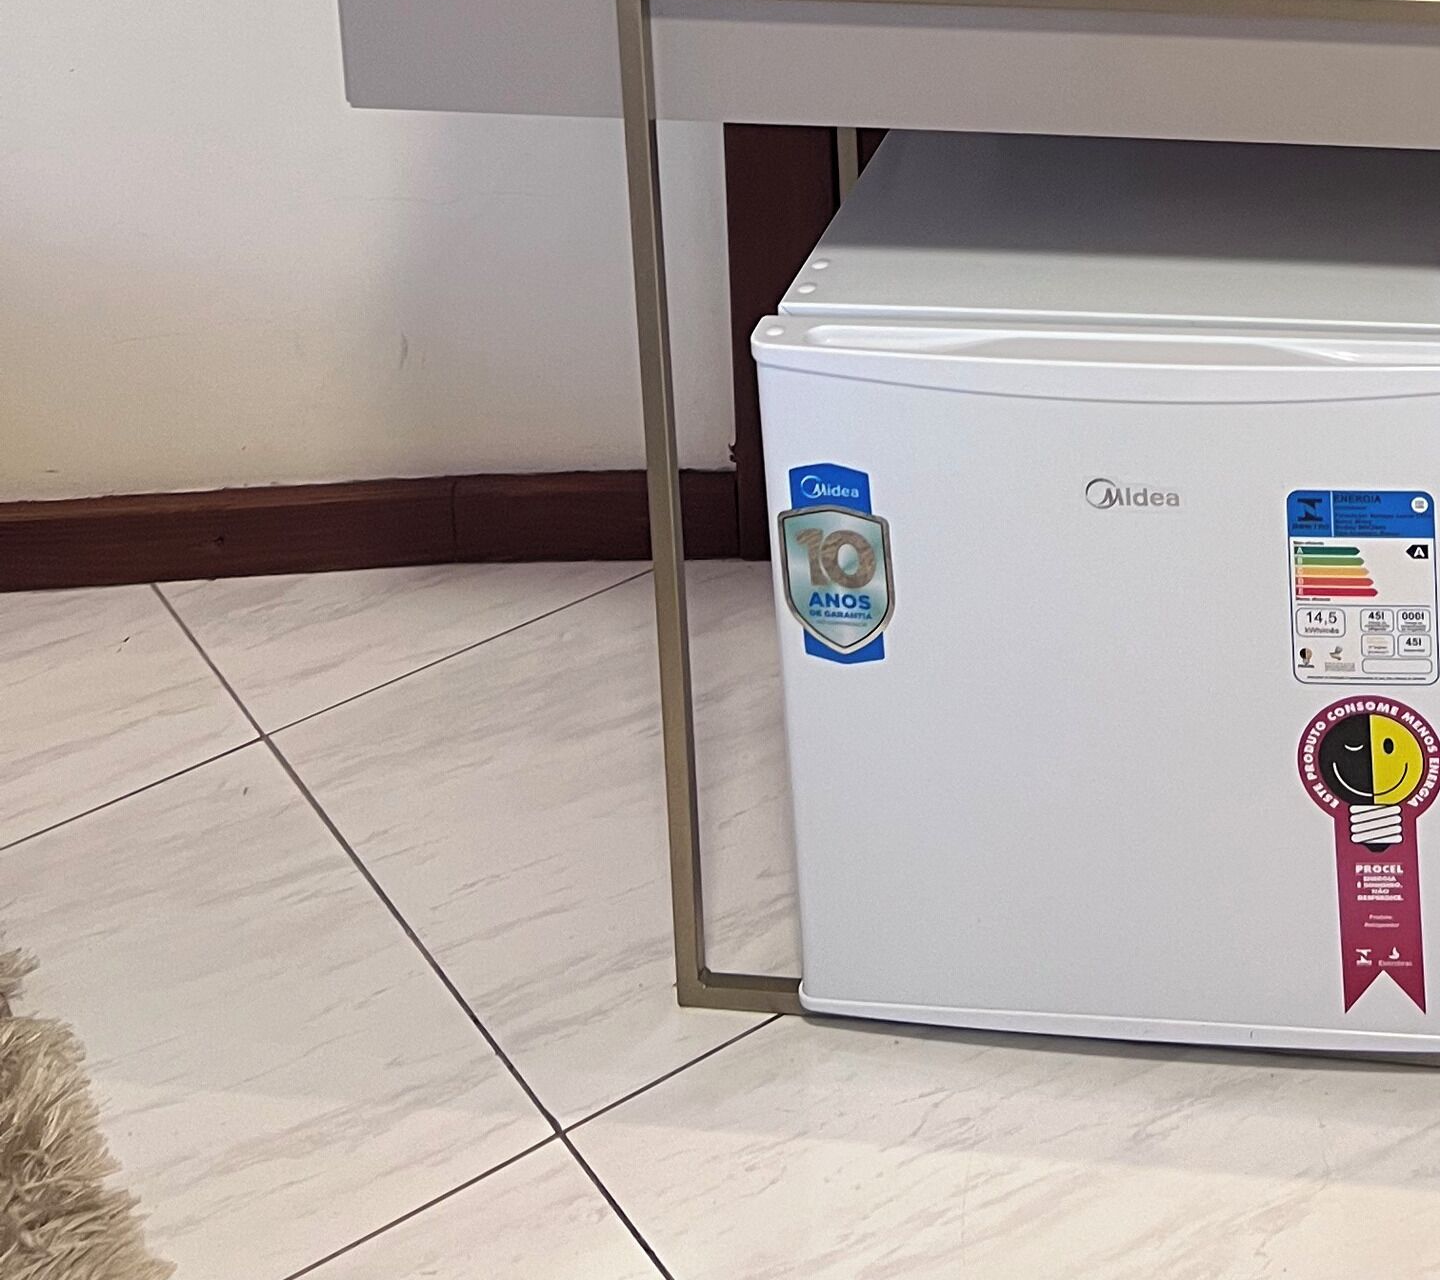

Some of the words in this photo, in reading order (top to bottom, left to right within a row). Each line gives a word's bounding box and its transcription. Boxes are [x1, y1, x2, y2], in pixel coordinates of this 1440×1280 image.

[801, 475, 860, 499] Midea
[795, 527, 877, 589] 10
[1413, 546, 1426, 558] A
[809, 591, 872, 610] ANOS
[825, 610, 873, 620] GARANTIA
[1306, 611, 1338, 625] 14,5
[1327, 701, 1400, 721] CONSOME
[1401, 711, 1438, 754] MENOS
[1303, 720, 1327, 781] PRODUTO
[1407, 757, 1440, 808] ENERGIA
[1312, 782, 1340, 809] ESTE
[1355, 864, 1404, 874] PROCEL
